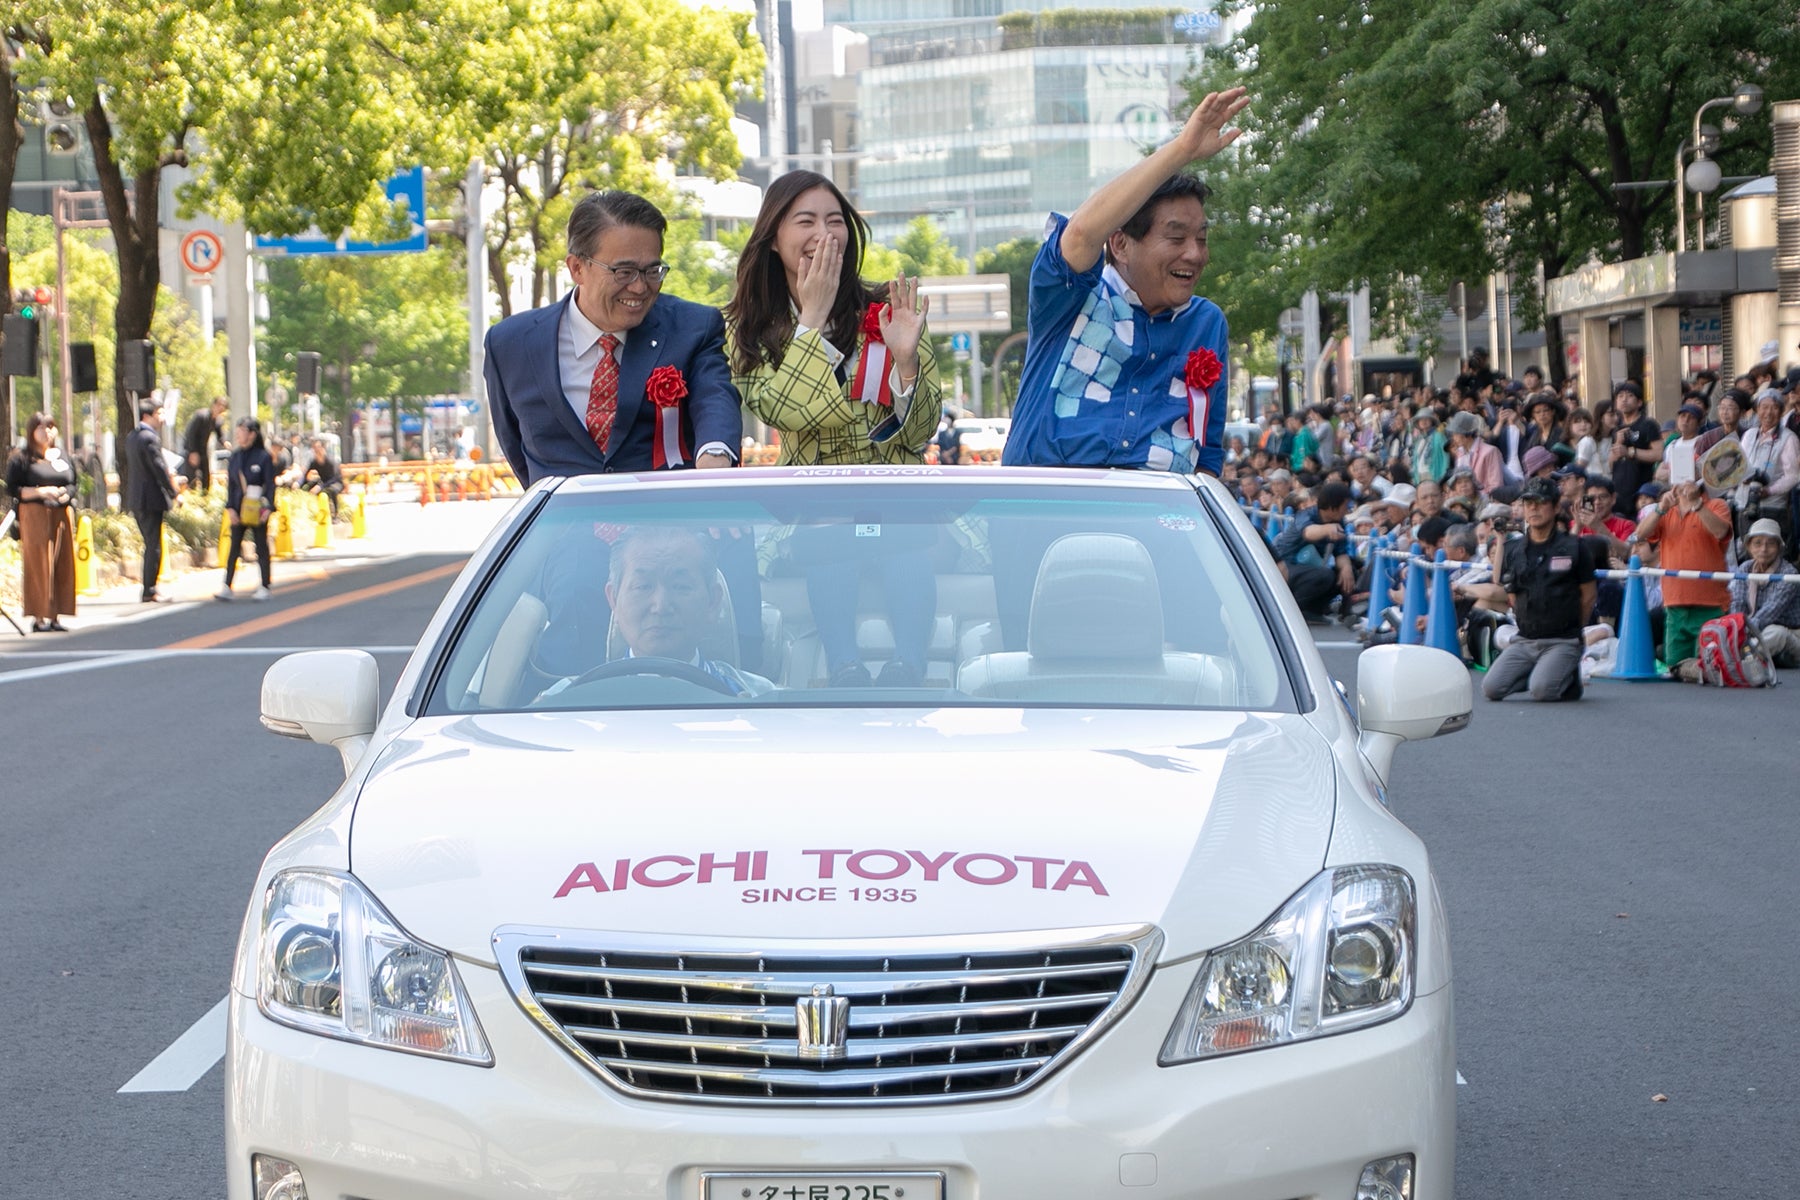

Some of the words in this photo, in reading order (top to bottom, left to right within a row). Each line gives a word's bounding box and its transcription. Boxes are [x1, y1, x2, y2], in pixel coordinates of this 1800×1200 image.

[793, 468, 851, 477] AICHI
[863, 468, 943, 476] TOYOTA
[278, 514, 288, 533] 3
[317, 508, 328, 525] 2
[78, 538, 90, 562] 6
[553, 850, 769, 898] AICHI
[802, 849, 1110, 897] TOYOTA
[741, 886, 837, 903] SINCE
[849, 887, 917, 903] 1935
